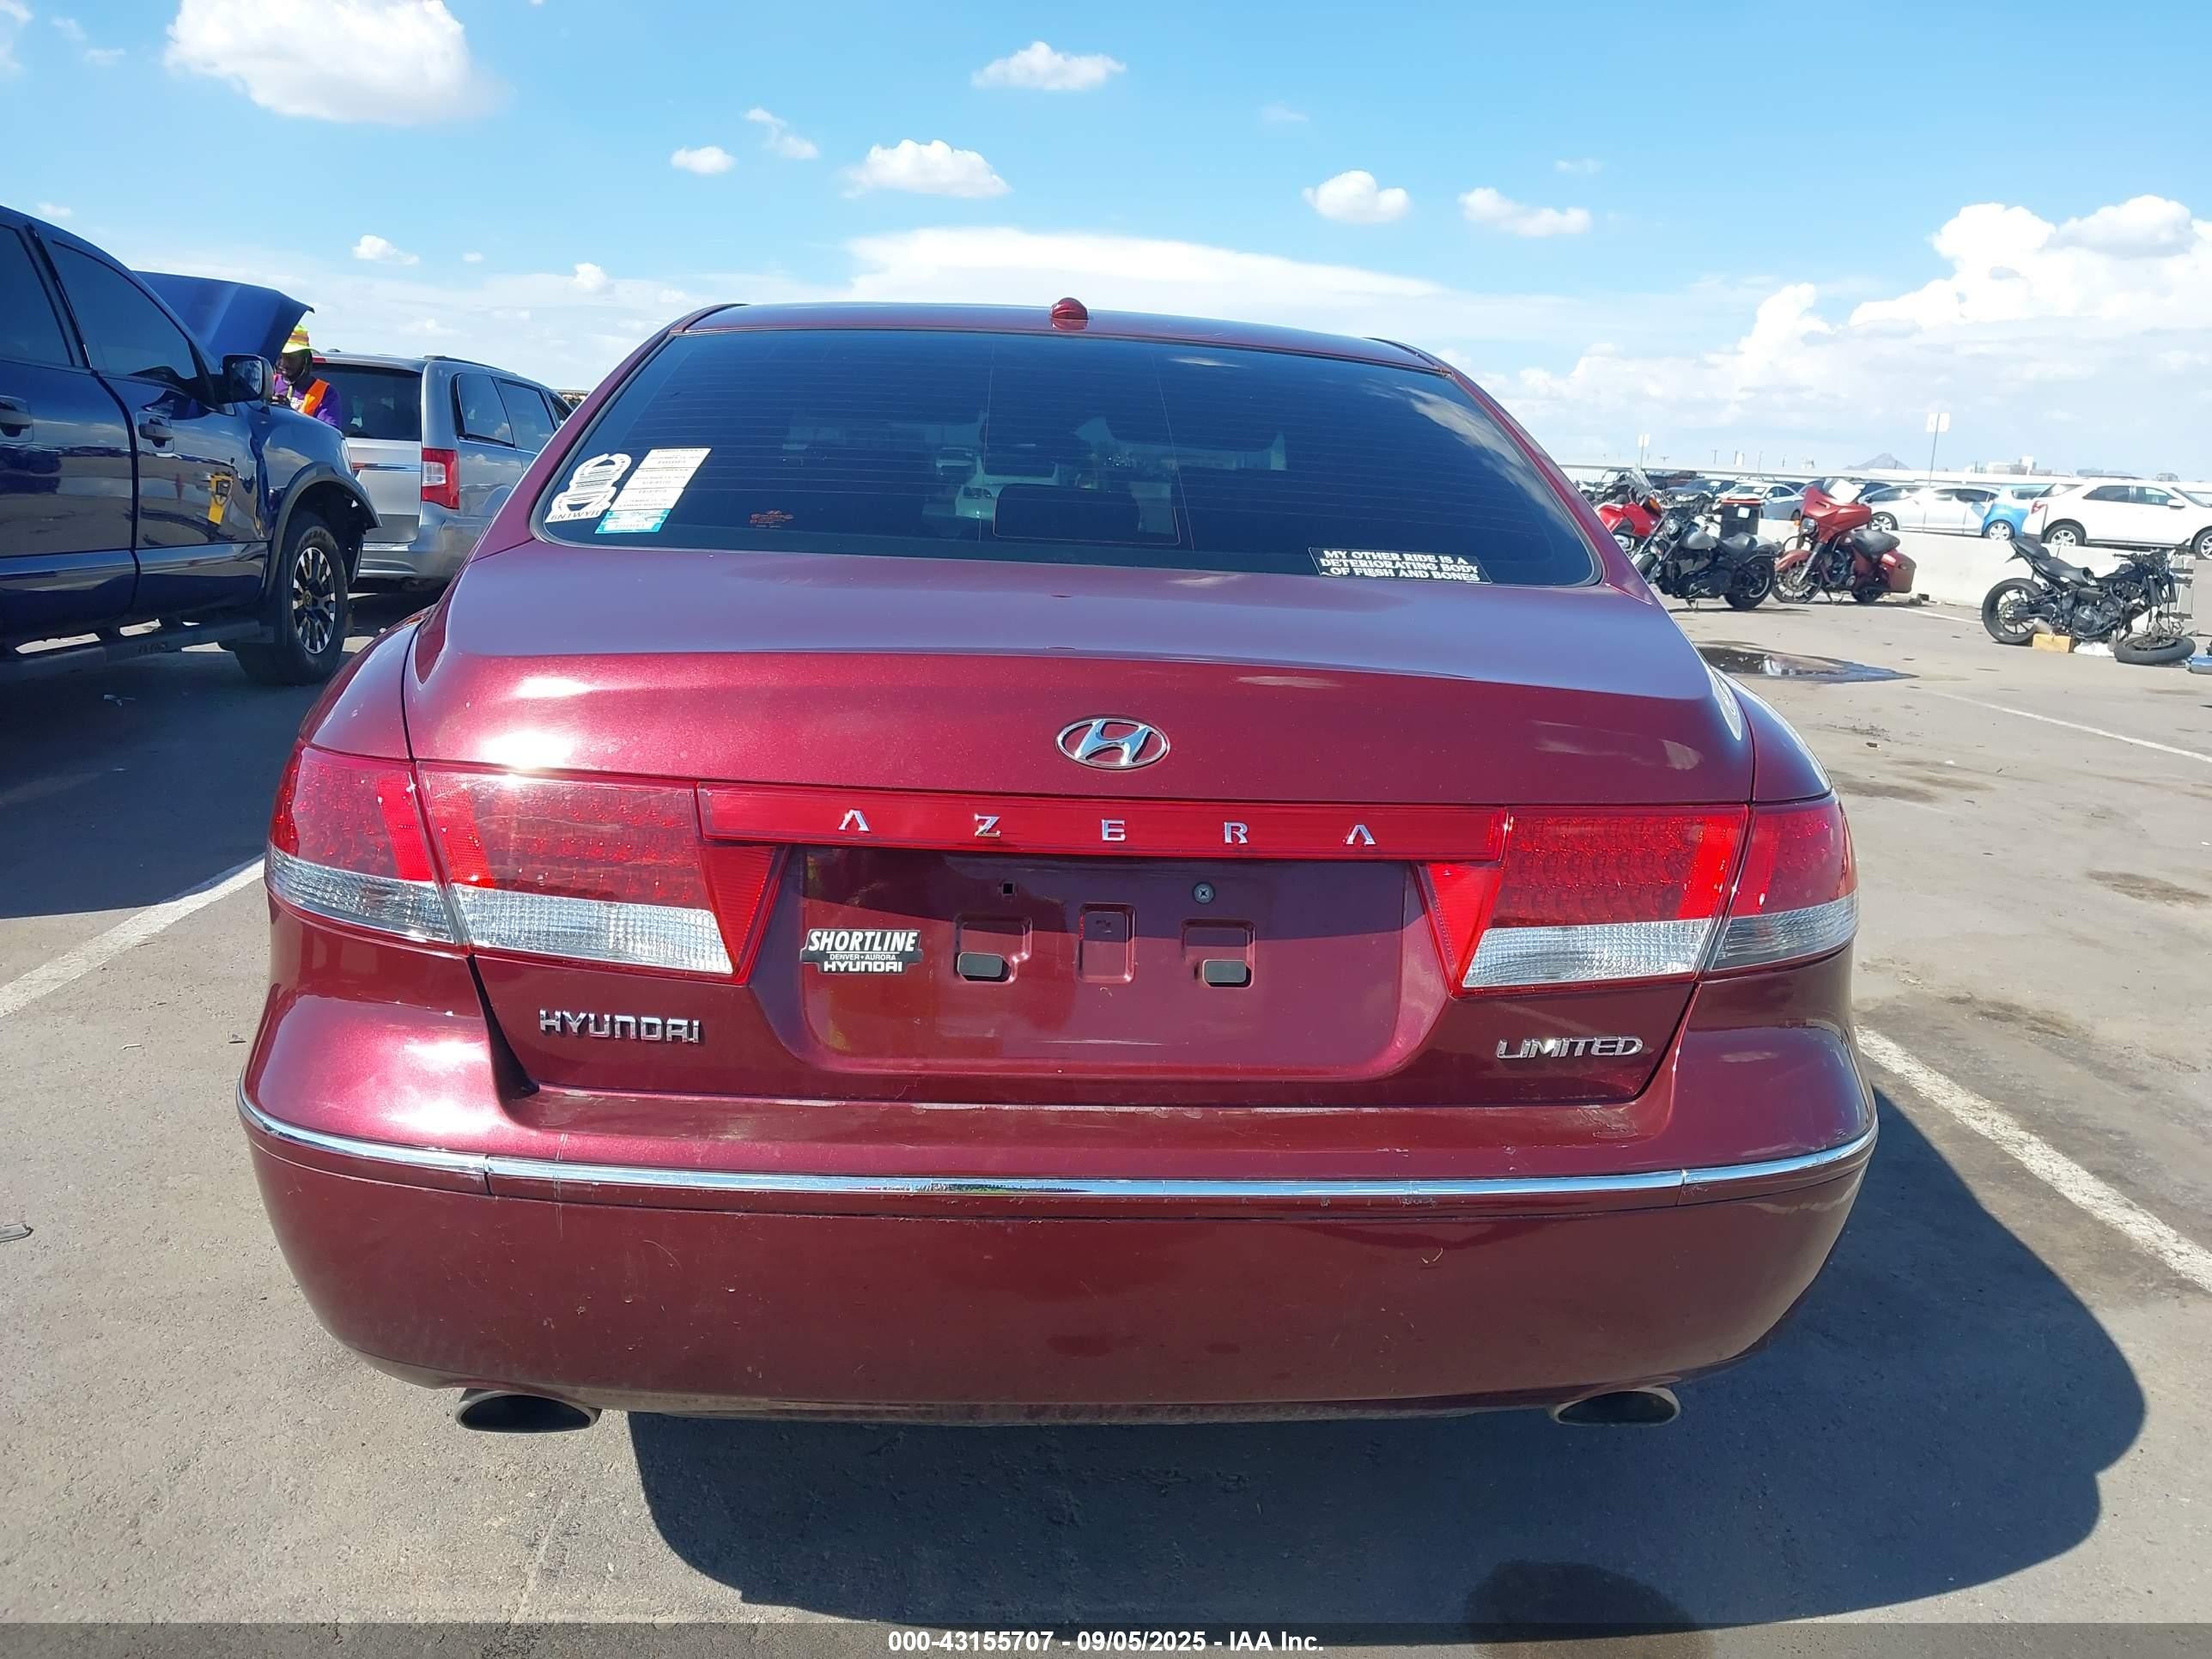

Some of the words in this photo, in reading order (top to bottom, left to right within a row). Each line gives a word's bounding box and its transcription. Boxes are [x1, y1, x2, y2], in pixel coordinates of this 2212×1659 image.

[1320, 558, 1438, 571] DETERIORATING
[1439, 563, 1479, 574] BODY
[1323, 550, 1347, 559] MY
[1352, 551, 1401, 561] OTHER
[1402, 553, 1438, 563] RIDE
[1438, 555, 1454, 564] IS
[1457, 556, 1468, 565] A
[1330, 567, 1351, 576] OF
[1353, 568, 1395, 577] FLESH
[1399, 569, 1430, 579] AND
[1431, 571, 1480, 581] BONES
[837, 809, 1376, 846] AZERA
[808, 930, 918, 952] SHORTLINE
[823, 961, 903, 972] HYUNDAI
[539, 1009, 701, 1044] HYUNDAI
[1497, 1036, 1644, 1060] LIMITED
